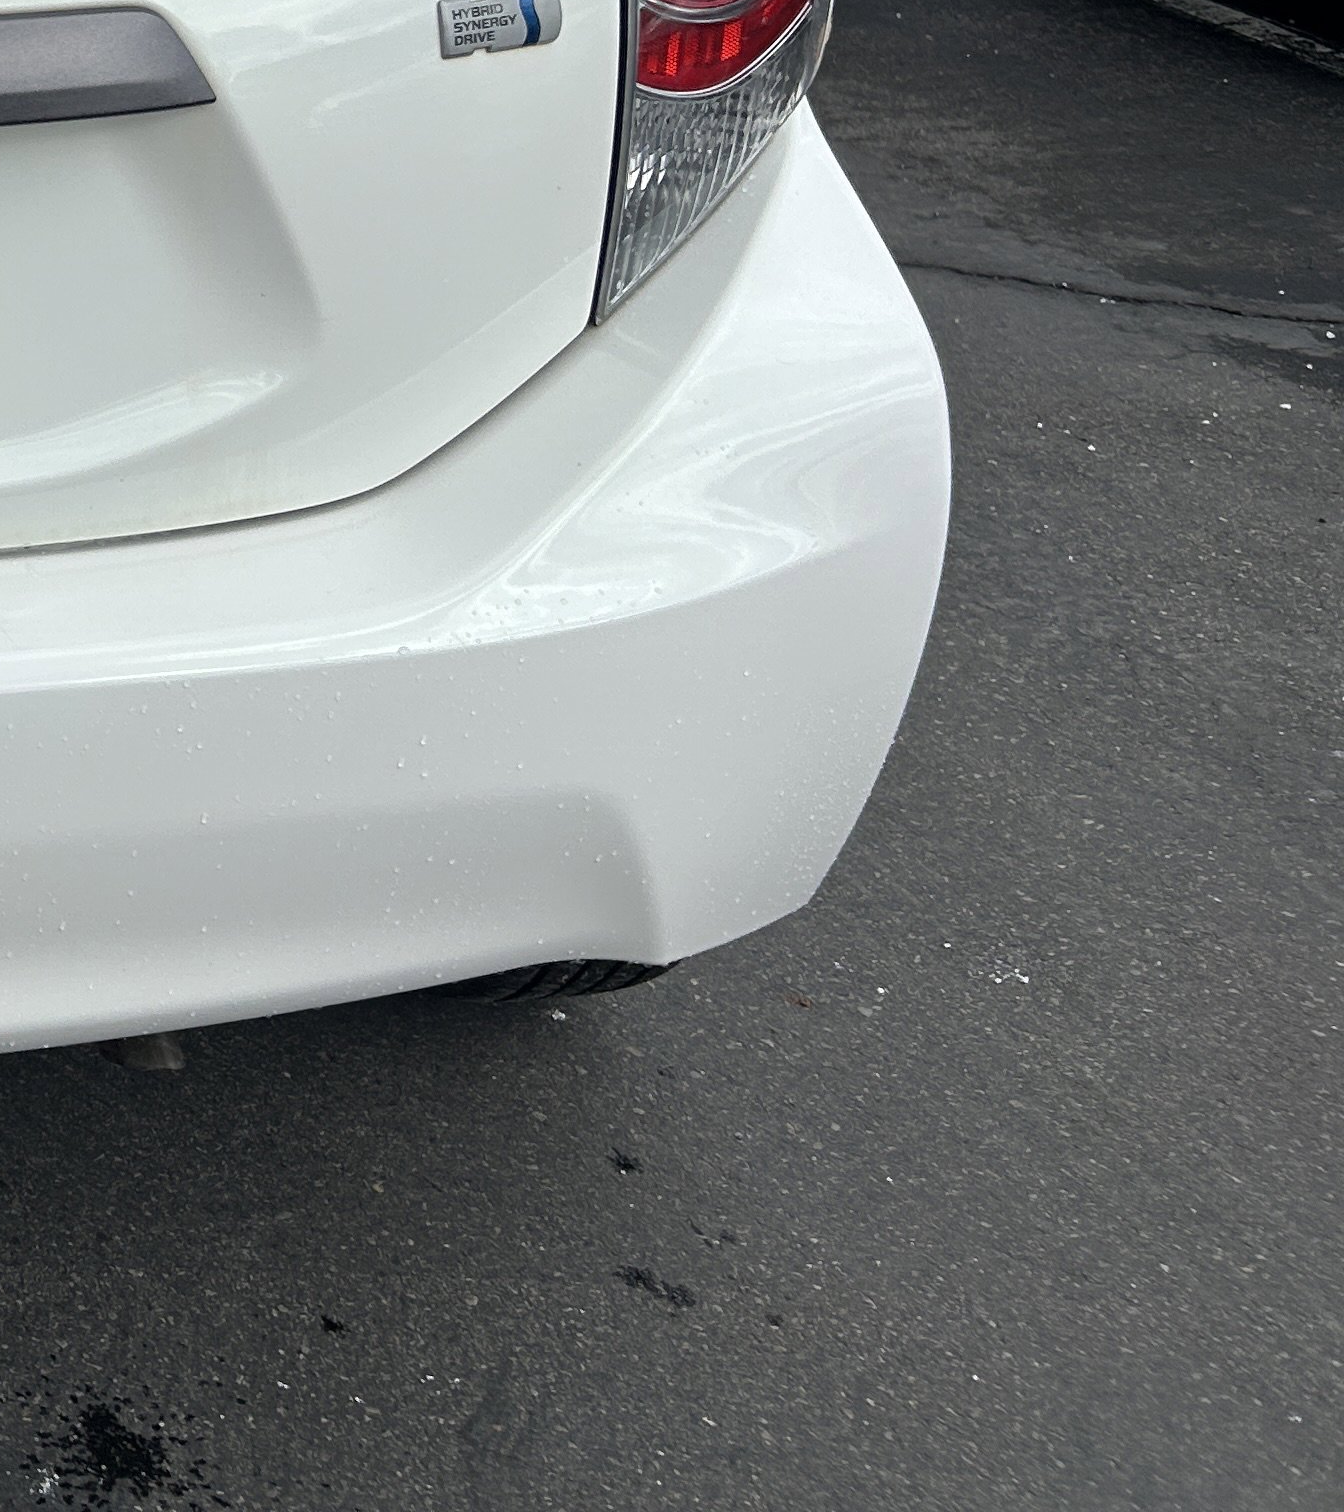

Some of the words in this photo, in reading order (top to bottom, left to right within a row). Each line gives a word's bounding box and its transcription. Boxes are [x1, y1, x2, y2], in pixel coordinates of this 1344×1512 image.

[452, 2, 504, 21] HYBRID
[453, 14, 517, 34] SYNERGY
[454, 30, 496, 47] DRIVE
